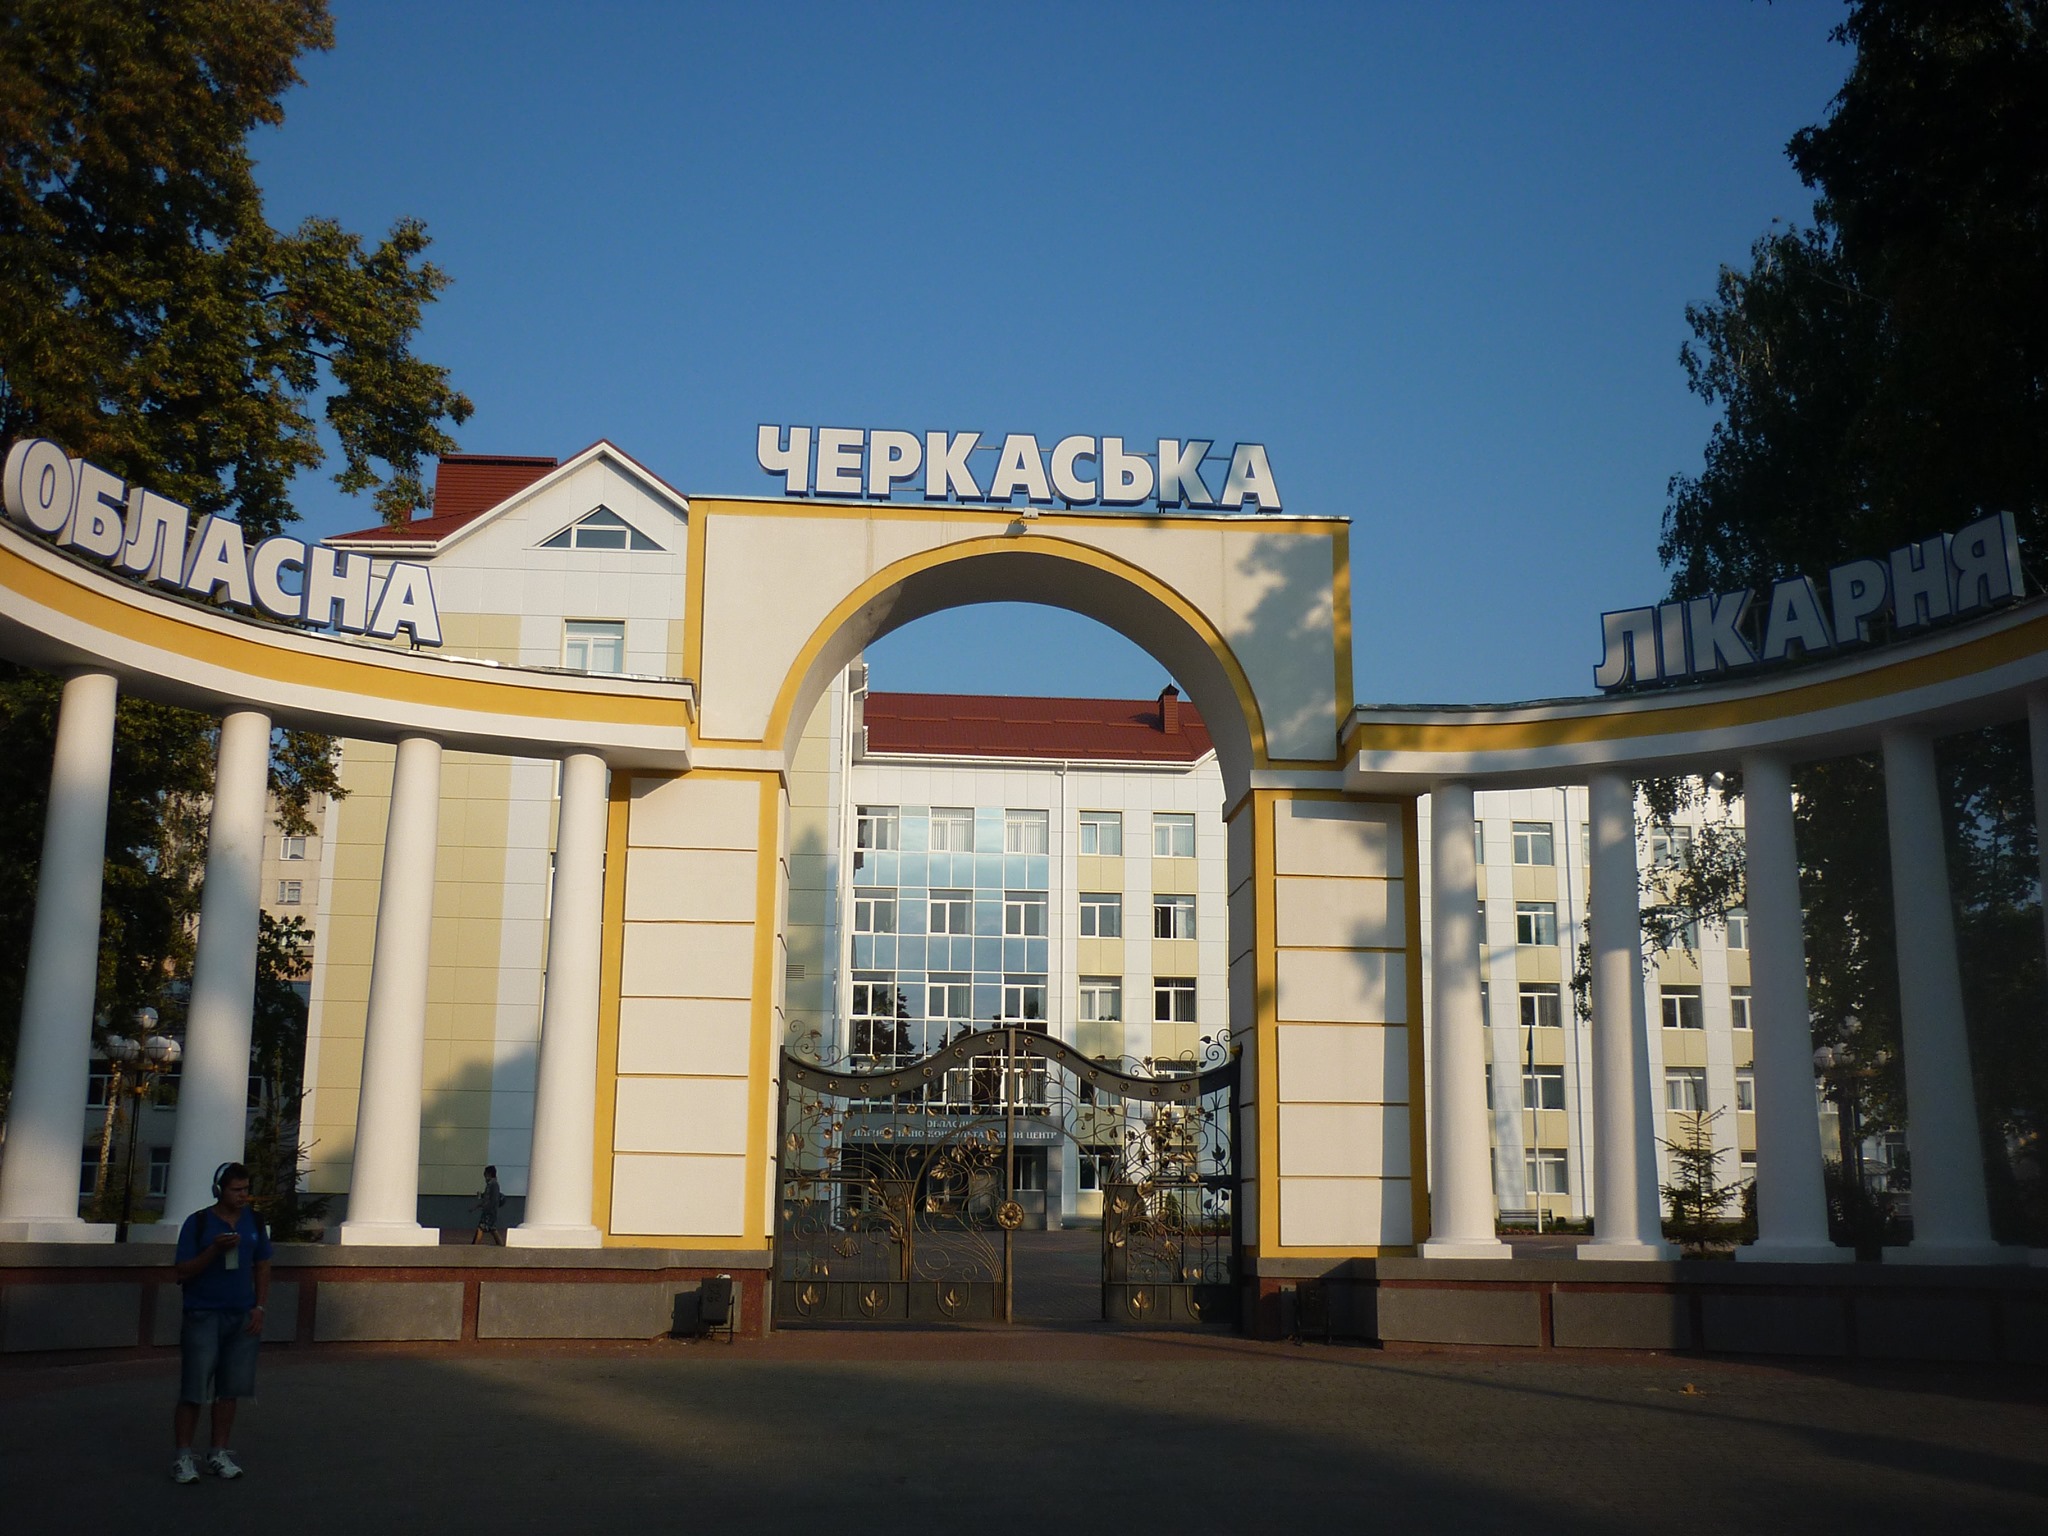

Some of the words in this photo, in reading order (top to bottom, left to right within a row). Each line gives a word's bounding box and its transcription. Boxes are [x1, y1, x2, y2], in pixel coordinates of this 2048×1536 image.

[756, 423, 1283, 513] ЧЕРКАСЬКА
[4, 438, 443, 647] ОБЛАСНА
[1594, 510, 2025, 688] ЛІКАРНЯ
[1026, 1131, 1057, 1140] ЦЕНТР
